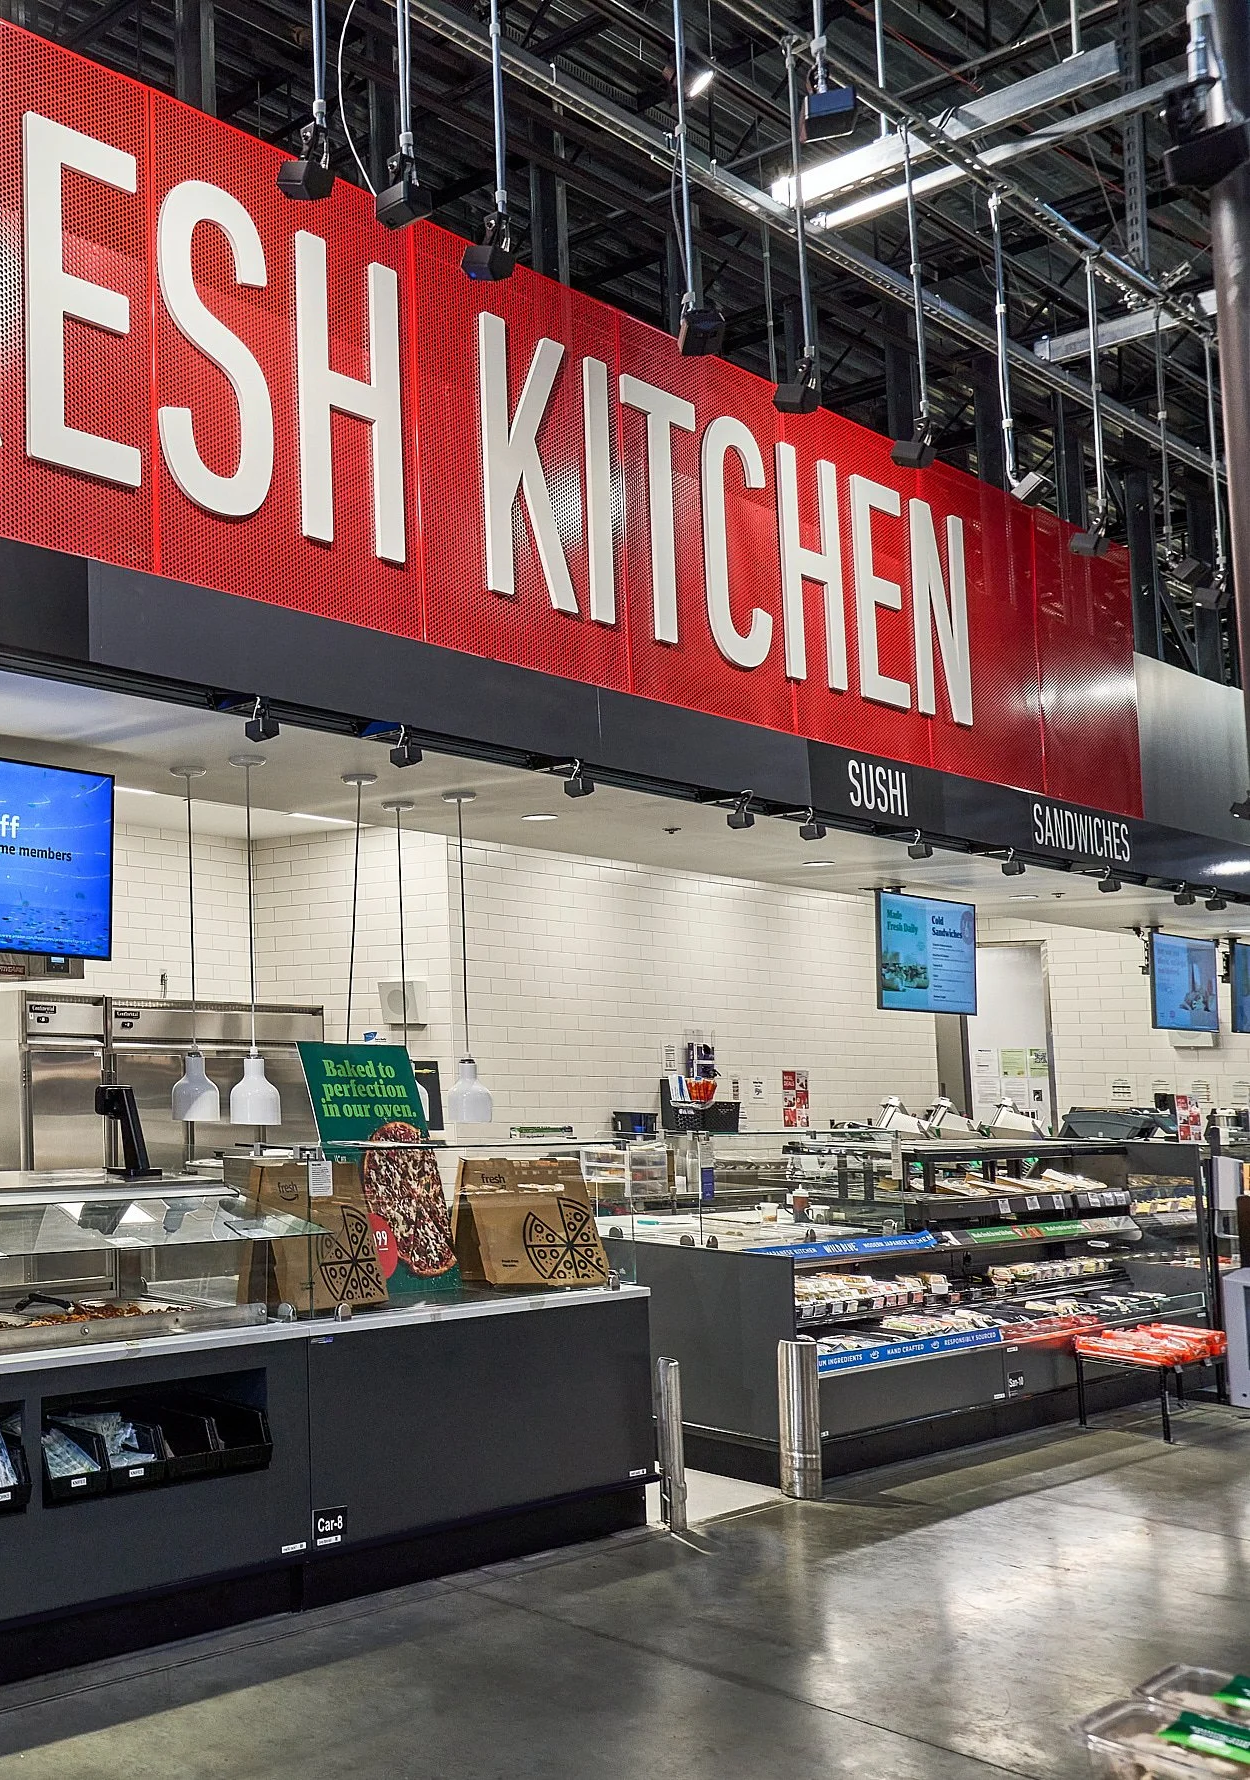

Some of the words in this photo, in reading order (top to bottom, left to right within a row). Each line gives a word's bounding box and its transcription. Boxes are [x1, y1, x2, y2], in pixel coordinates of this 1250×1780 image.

[479, 311, 973, 727] KITCHEN
[848, 760, 909, 818] SUSHI
[1033, 804, 1130, 862] SANDWICHES
[18, 847, 72, 862] members
[931, 916, 944, 926] Cold
[932, 927, 963, 939] Sandwiches
[322, 1059, 377, 1078] Baked
[378, 1062, 396, 1078] to
[322, 1079, 408, 1101] perfection
[321, 1098, 341, 1117] in
[342, 1103, 371, 1117] our
[373, 1103, 417, 1118] oven.
[481, 1174, 505, 1184] fresh
[277, 1182, 298, 1194] fresh
[823, 1244, 842, 1253] WILD
[944, 1336, 975, 1347] RESPONSIBLY
[975, 1331, 997, 1342] SOURCED
[887, 1347, 901, 1356] HAND
[902, 1343, 924, 1354] CRAFTED
[828, 1353, 862, 1366] INGREDIENTS
[318, 1514, 343, 1533] Car-8
